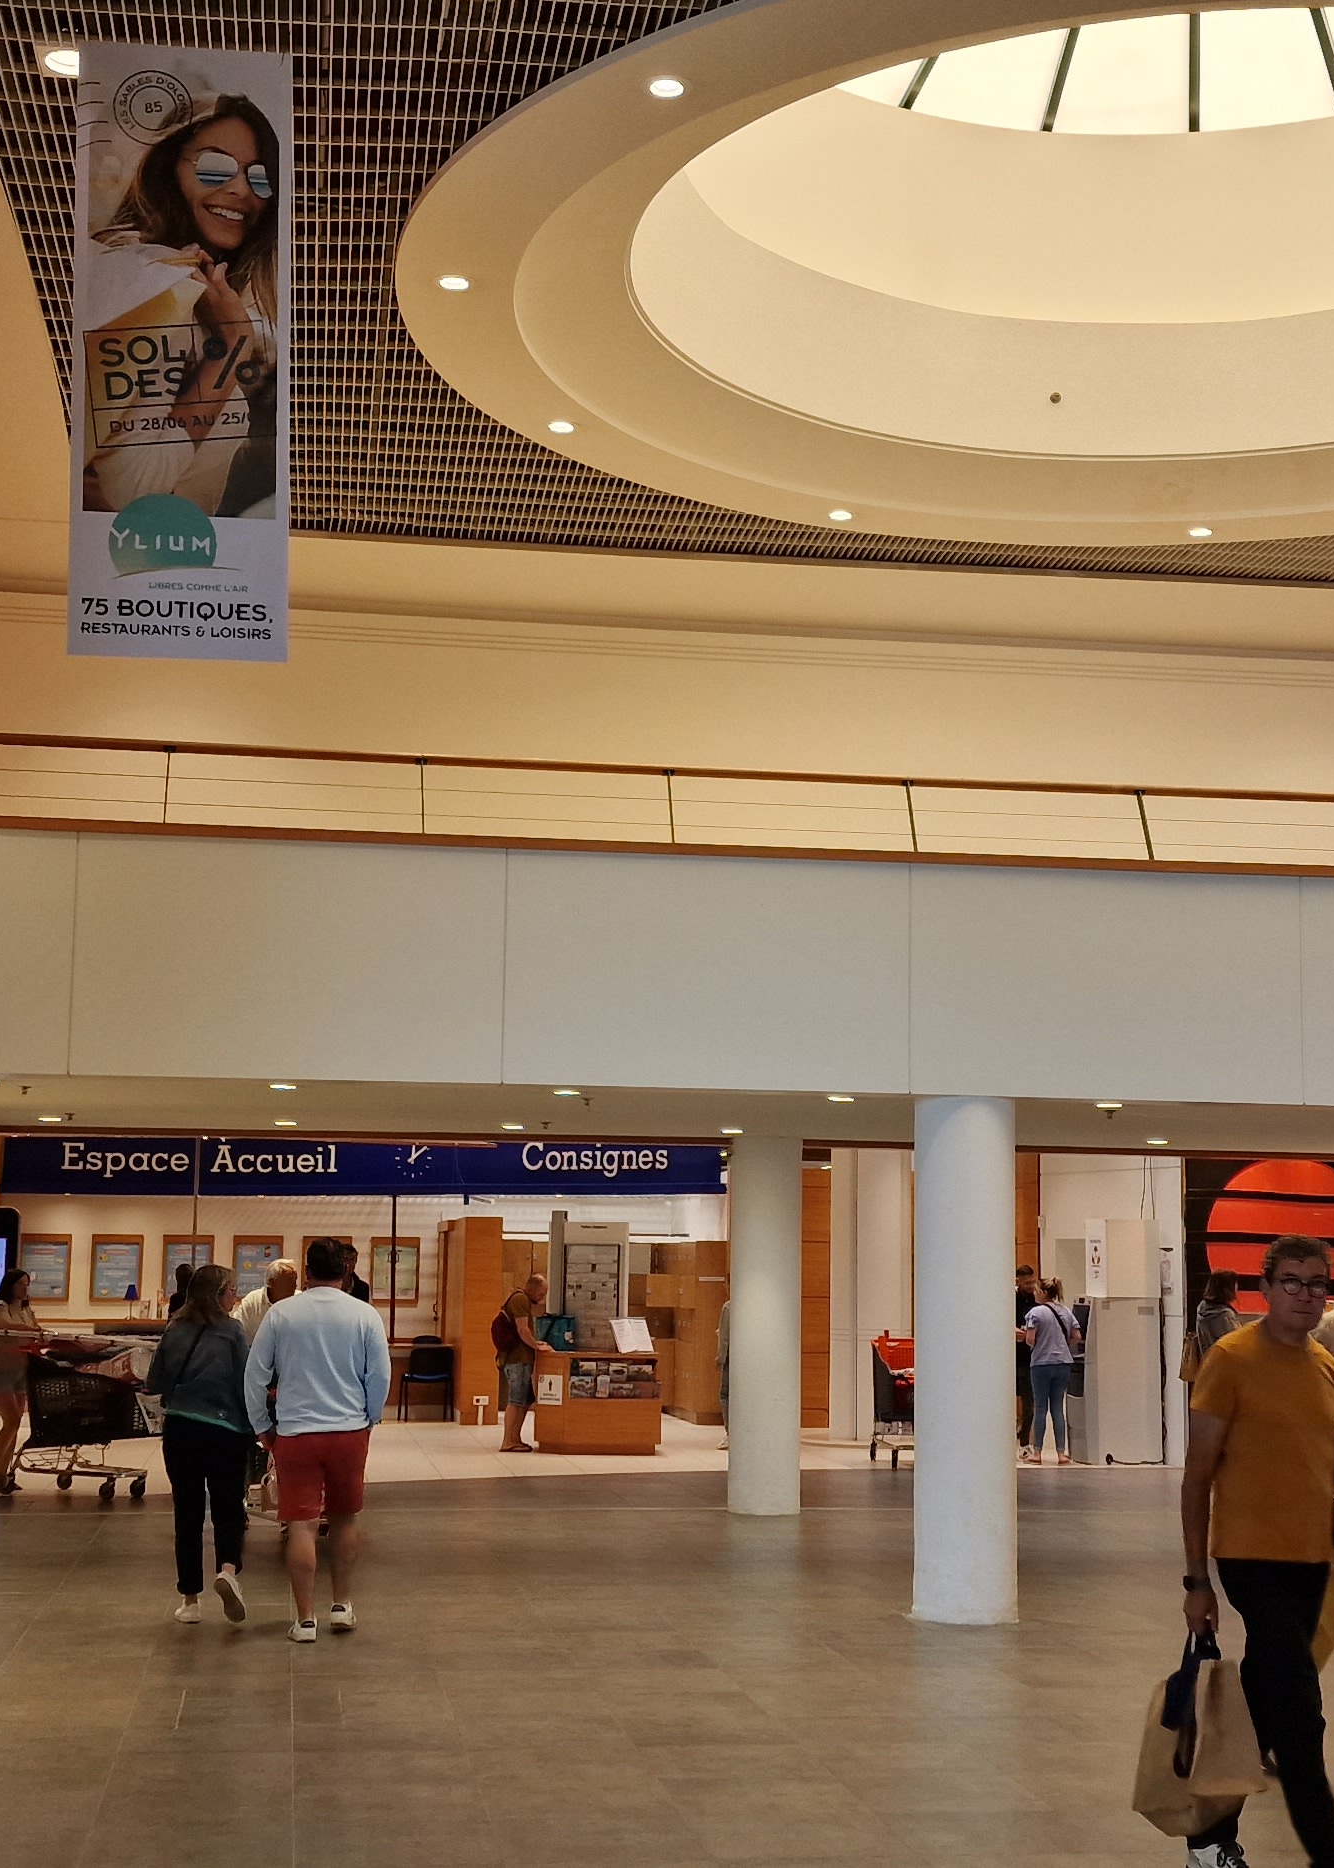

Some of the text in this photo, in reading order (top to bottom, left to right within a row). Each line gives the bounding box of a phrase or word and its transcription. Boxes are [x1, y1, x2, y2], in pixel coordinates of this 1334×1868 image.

[119, 76, 153, 107] SABLES
[144, 101, 163, 114] 85
[99, 335, 186, 367] SOL
[104, 367, 185, 401] DES
[110, 418, 134, 434] DU
[192, 414, 215, 427] AU
[109, 528, 211, 556] YLIUM
[148, 582, 249, 594] LIBRES COMME L'AIR
[81, 597, 273, 624] 75 BOUTIQUES,
[80, 622, 272, 640] RESTAURANTS & LOISIRS
[61, 1141, 668, 1178] Espace Accueil Consignes
